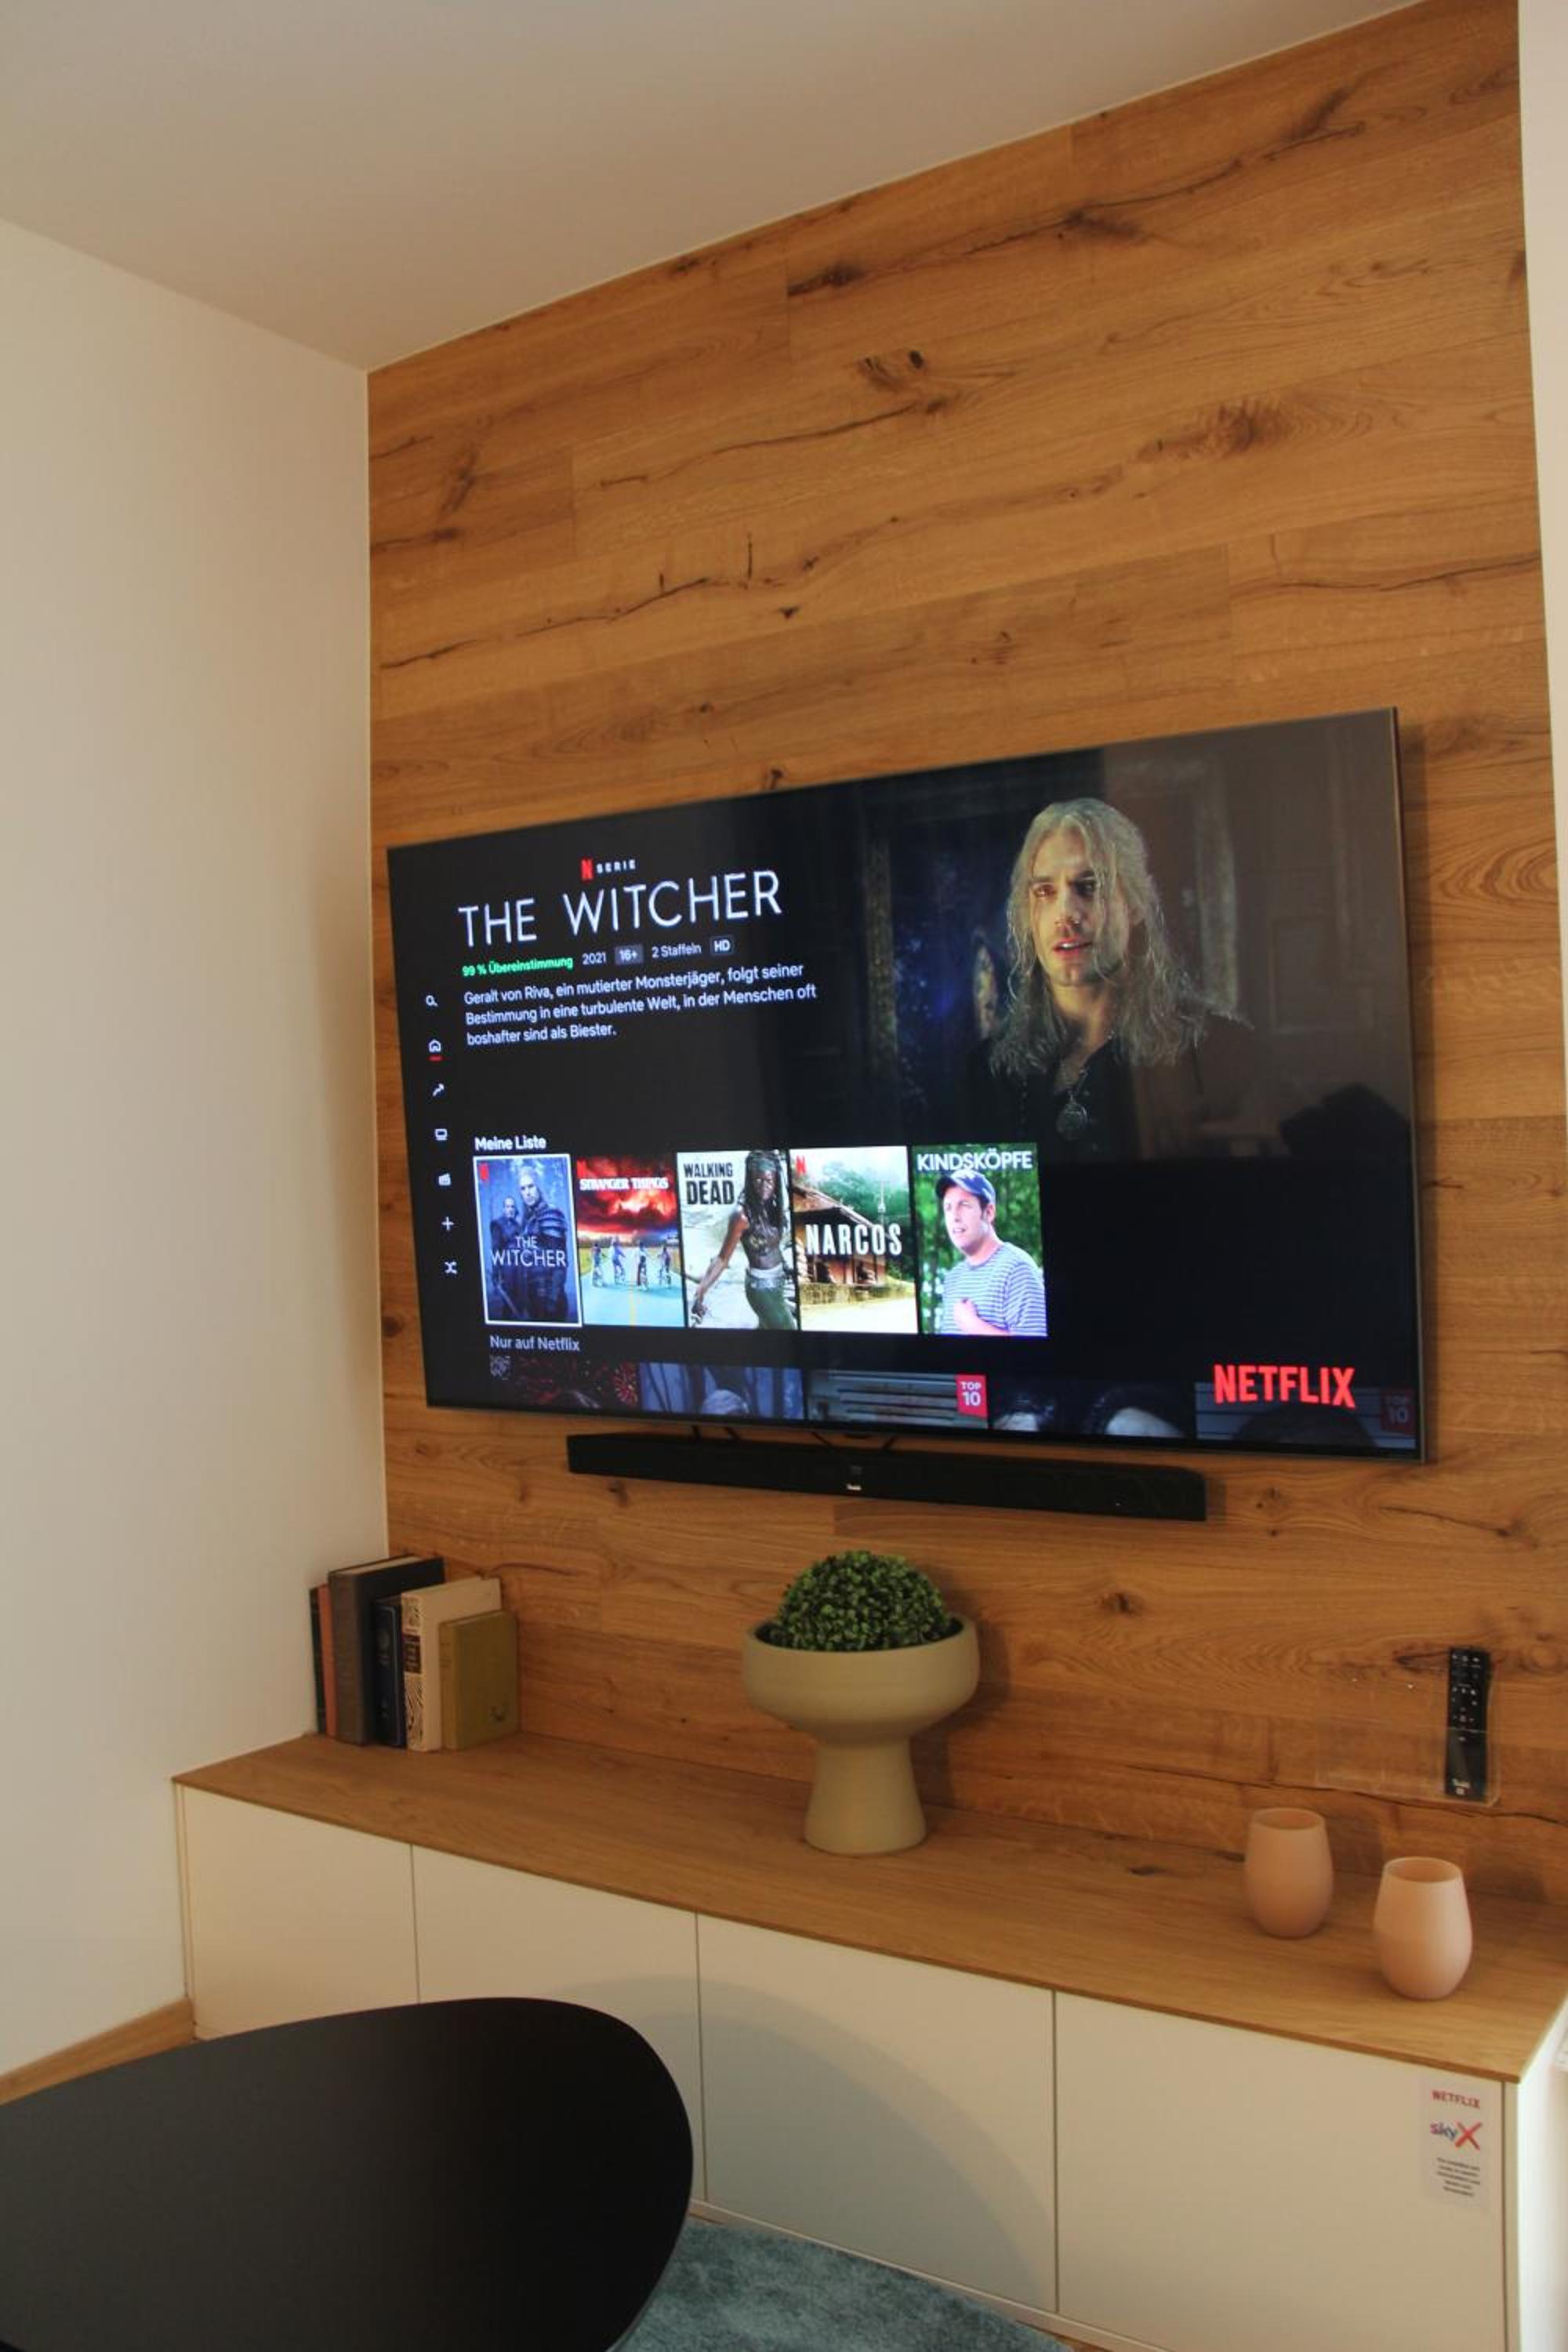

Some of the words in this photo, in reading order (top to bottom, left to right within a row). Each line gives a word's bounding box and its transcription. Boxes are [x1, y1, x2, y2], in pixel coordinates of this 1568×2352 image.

[596, 859, 636, 873] SERIE
[458, 898, 537, 947] THE
[563, 869, 782, 936] WITCHER
[619, 949, 638, 961] 16+
[652, 946, 659, 959] 2
[661, 942, 702, 957] Staffeln
[714, 940, 731, 952] HD
[462, 965, 476, 977] 99
[477, 964, 487, 975] %
[488, 956, 574, 975] Übereinstimmung
[582, 952, 607, 965] 2021
[464, 991, 499, 1005] Geralt
[501, 989, 522, 1002] von
[524, 985, 554, 1000] Riva,
[556, 983, 575, 996] ein
[576, 977, 633, 995] mutierter
[635, 971, 725, 989] Monsterjäger,
[727, 964, 759, 984] folgt
[761, 964, 804, 979] seiner
[466, 1007, 537, 1025] Bestimmung
[539, 1006, 551, 1019] in
[553, 1003, 579, 1018] eine
[581, 997, 644, 1015] turbulente
[648, 996, 681, 1011] Welt,
[683, 993, 695, 1007] in
[698, 990, 720, 1006] der
[723, 984, 794, 1004] Menschen
[797, 983, 817, 999] oft
[466, 1029, 521, 1046] boshafter
[523, 1025, 549, 1041] sind
[550, 1024, 568, 1040] als
[570, 1022, 617, 1037] Biester.
[475, 1136, 513, 1151] Meine
[515, 1134, 546, 1149] Liste
[917, 1148, 1033, 1171] KINDSKÖPFE
[684, 1162, 733, 1178] WALKING
[686, 1180, 735, 1205] DEAD
[516, 1236, 539, 1250] THE
[805, 1223, 902, 1256] NARCOS
[491, 1249, 567, 1268] WITCHER
[489, 1335, 513, 1348] Nur
[515, 1336, 535, 1349] auf
[537, 1337, 580, 1352] Netflix
[960, 1381, 981, 1391] TOP
[1214, 1364, 1356, 1409] NETFLIX
[962, 1392, 981, 1406] 10
[1432, 2090, 1481, 2109] NETFLIX
